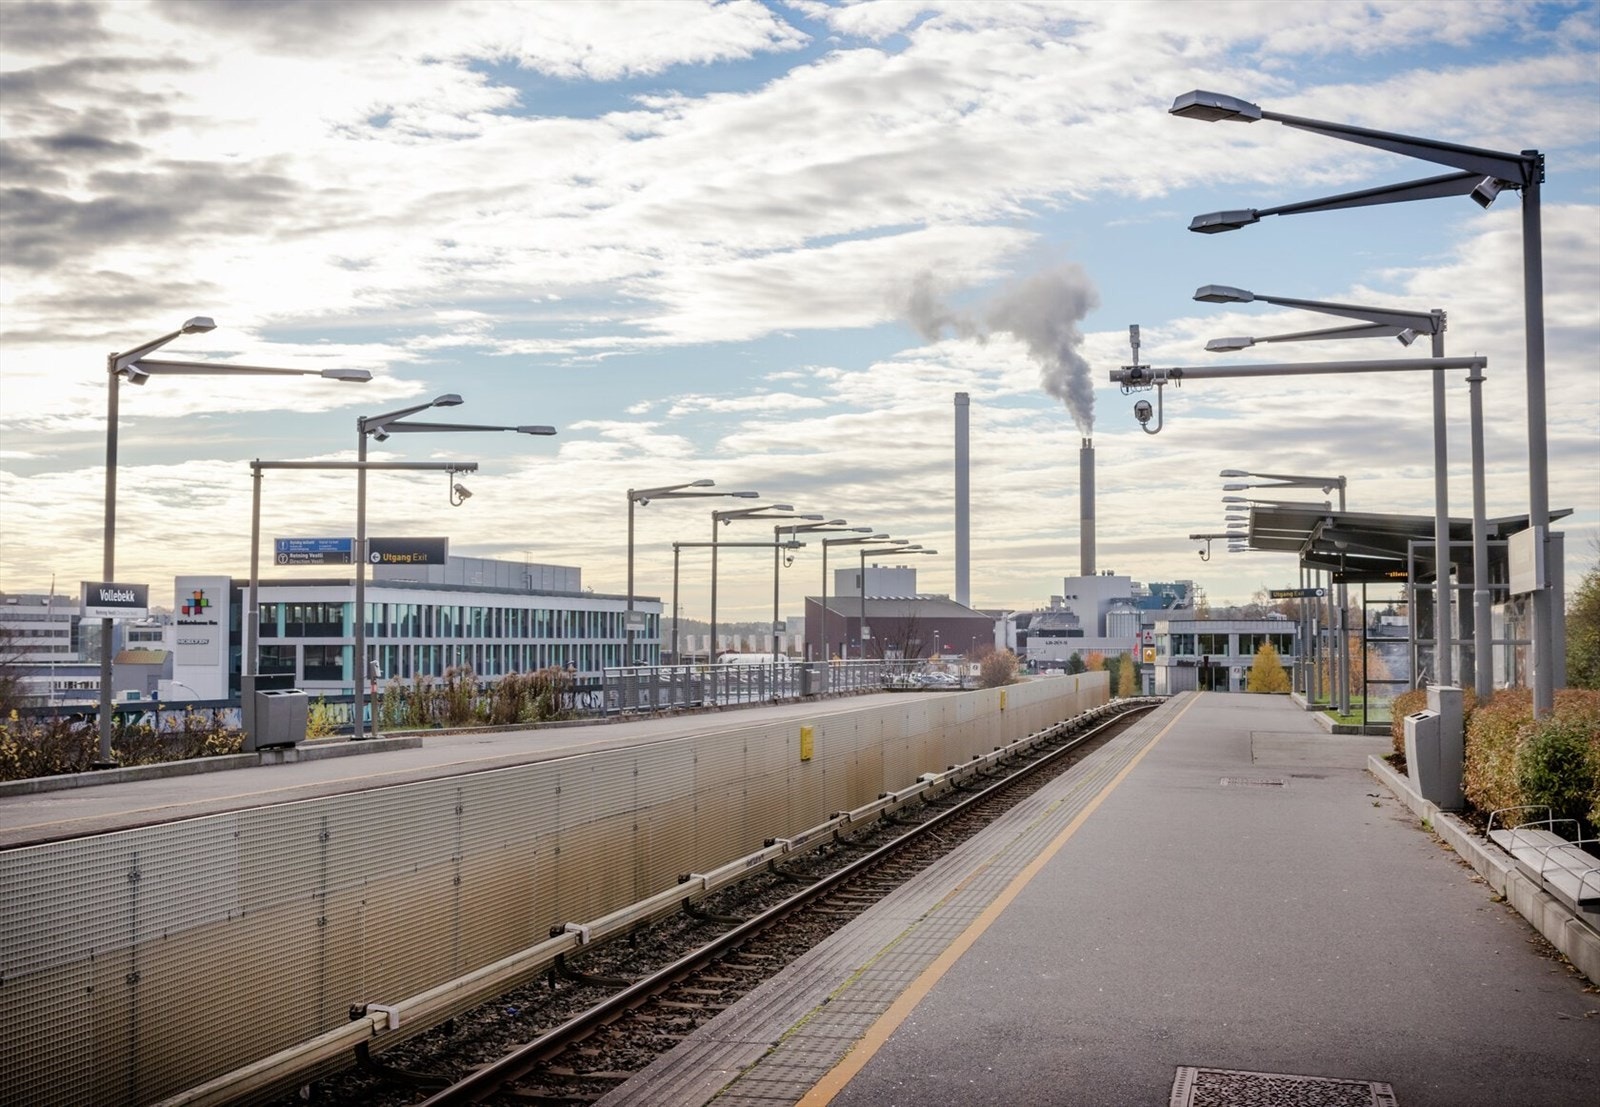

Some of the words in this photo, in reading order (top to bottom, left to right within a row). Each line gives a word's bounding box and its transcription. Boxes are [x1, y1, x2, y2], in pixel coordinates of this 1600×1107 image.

[383, 553, 411, 562] Utgang
[413, 553, 427, 561] Exit
[100, 589, 135, 602] Vollebekk
